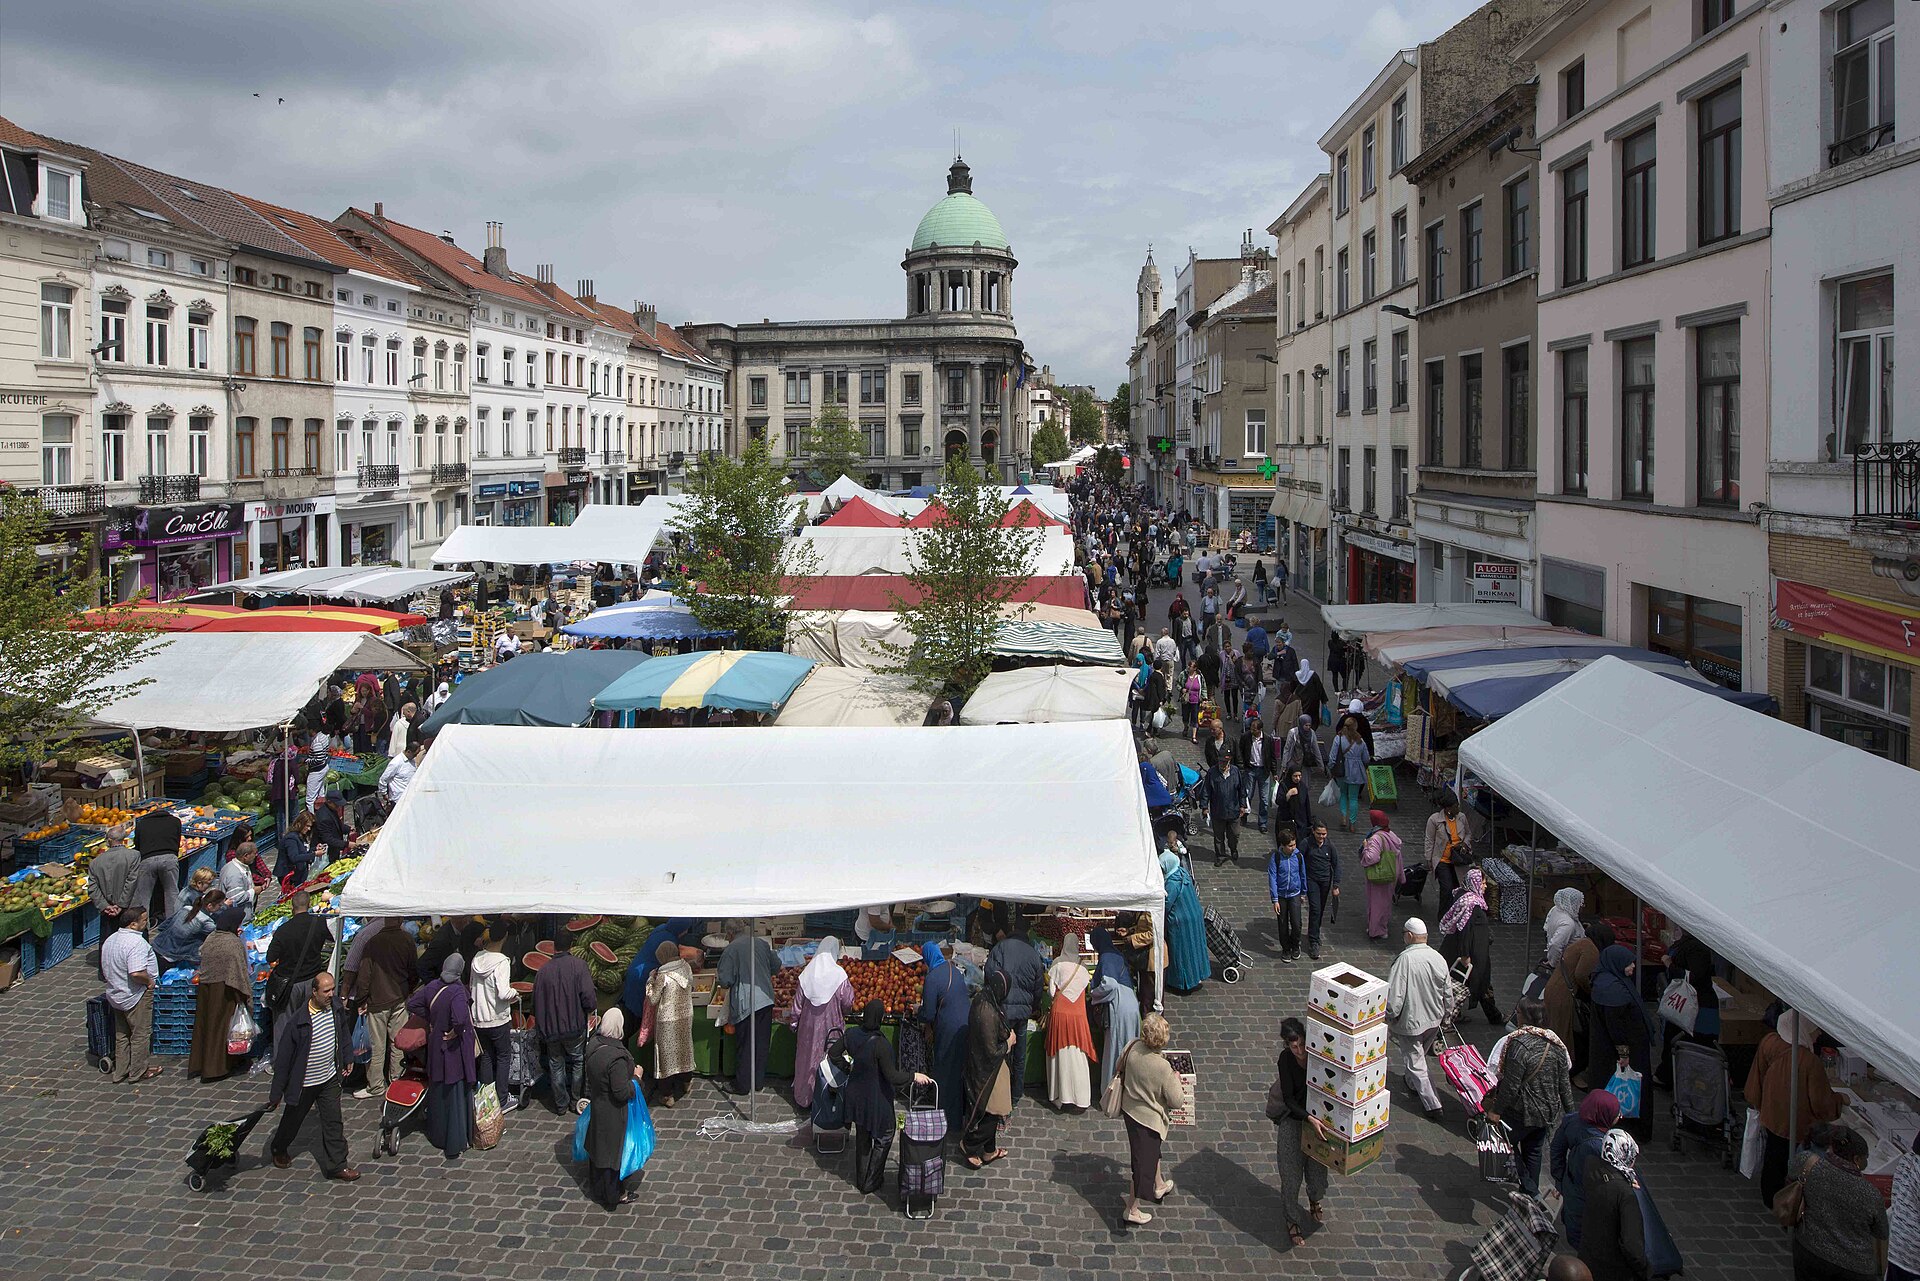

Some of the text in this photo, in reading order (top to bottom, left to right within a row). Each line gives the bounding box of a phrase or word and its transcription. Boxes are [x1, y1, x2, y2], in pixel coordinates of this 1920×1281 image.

[0, 394, 47, 405] RCUTERIE
[286, 502, 317, 515] MOURY
[165, 510, 229, 535] Com'Elle
[1485, 565, 1515, 573] LOUER
